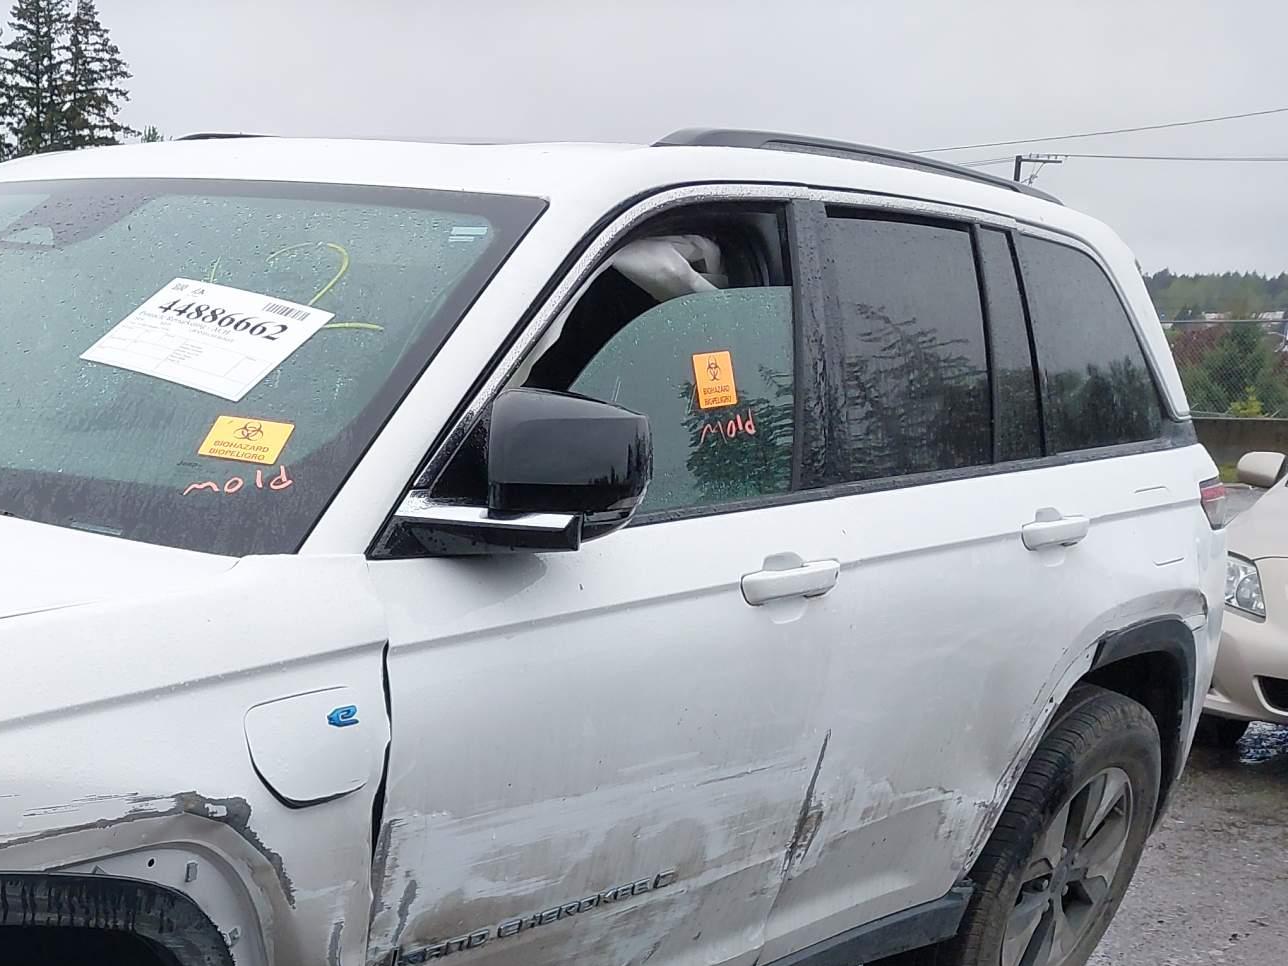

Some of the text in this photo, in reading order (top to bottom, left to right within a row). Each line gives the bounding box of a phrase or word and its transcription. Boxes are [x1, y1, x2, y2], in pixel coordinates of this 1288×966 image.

[158, 299, 288, 341] 44886662
[208, 447, 266, 461] BIOPELIGRO
[213, 440, 270, 453] BIOHAZARD
[182, 464, 294, 496] mold
